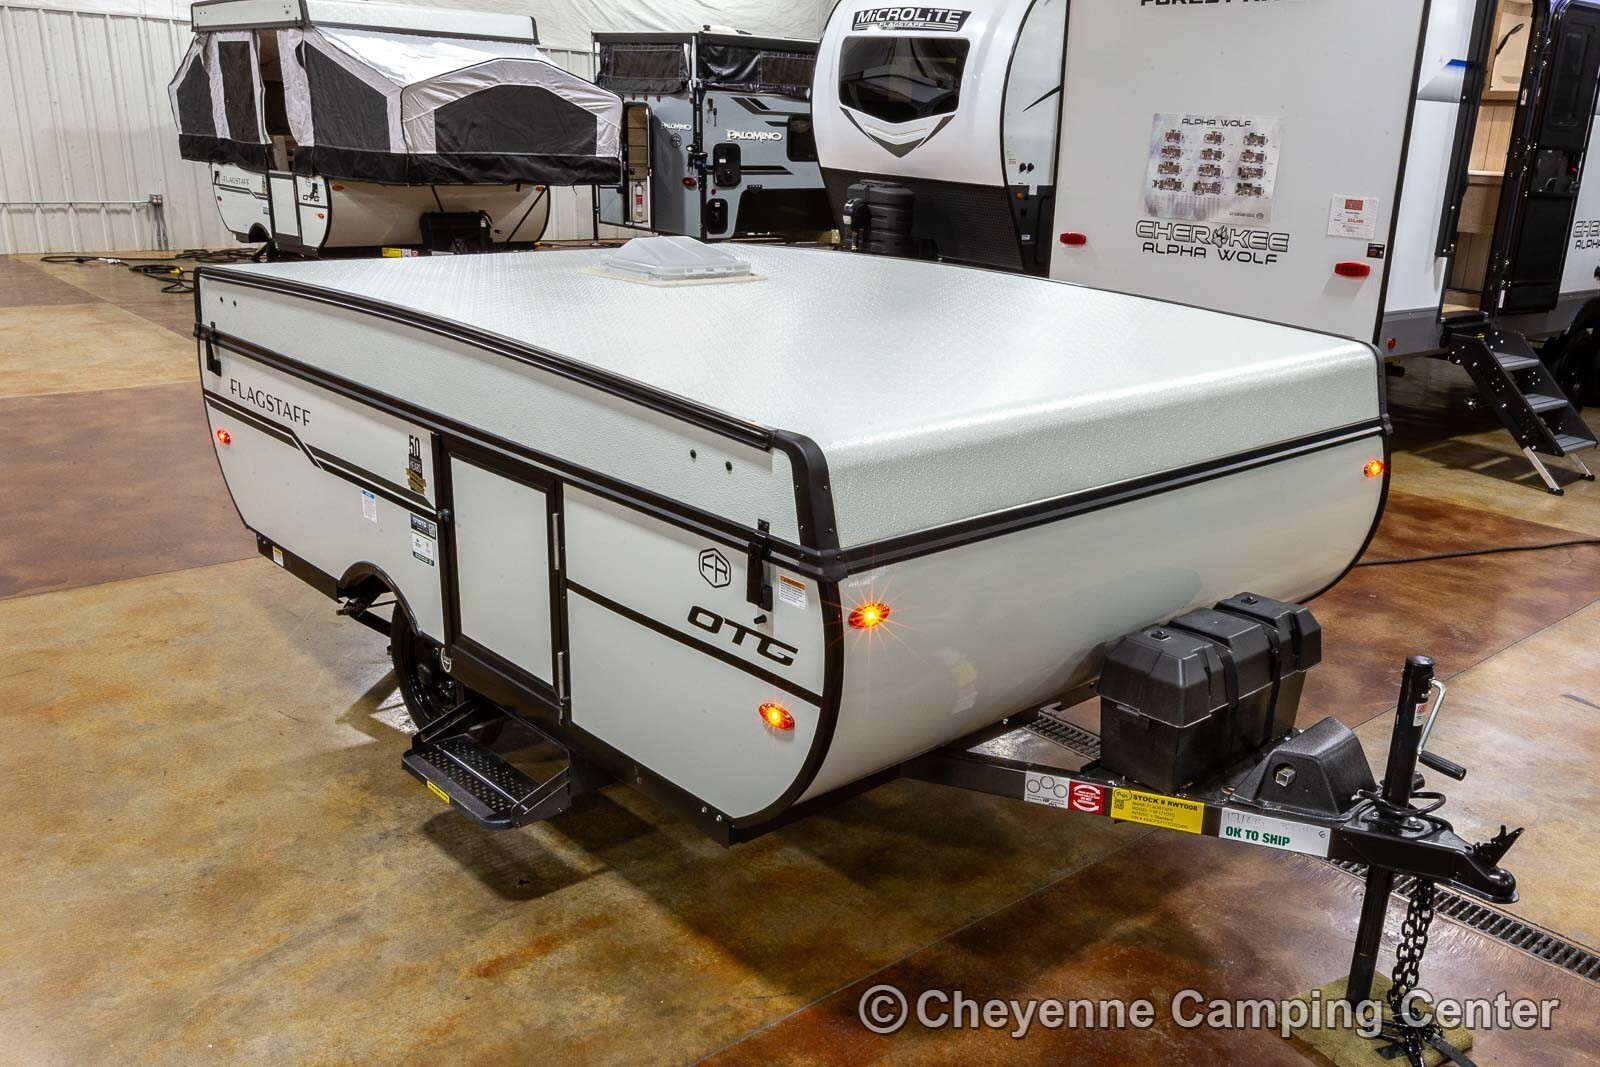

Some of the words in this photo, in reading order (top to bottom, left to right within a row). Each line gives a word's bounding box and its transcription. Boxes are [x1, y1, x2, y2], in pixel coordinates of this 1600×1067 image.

[1182, 118, 1216, 126] ALPHA
[1220, 119, 1252, 127] WOLF
[223, 175, 250, 185] FLAGSTAFF
[1142, 242, 1207, 259] ALPHA
[1217, 249, 1278, 265] WOLF
[230, 378, 311, 426] FLAGSTAFF
[409, 434, 420, 457] 50
[687, 605, 799, 666] OTG
[1133, 794, 1159, 804] STOCK
[1225, 826, 1242, 838] OK
[1245, 829, 1259, 841] TO
[1262, 833, 1290, 846] SHIP
